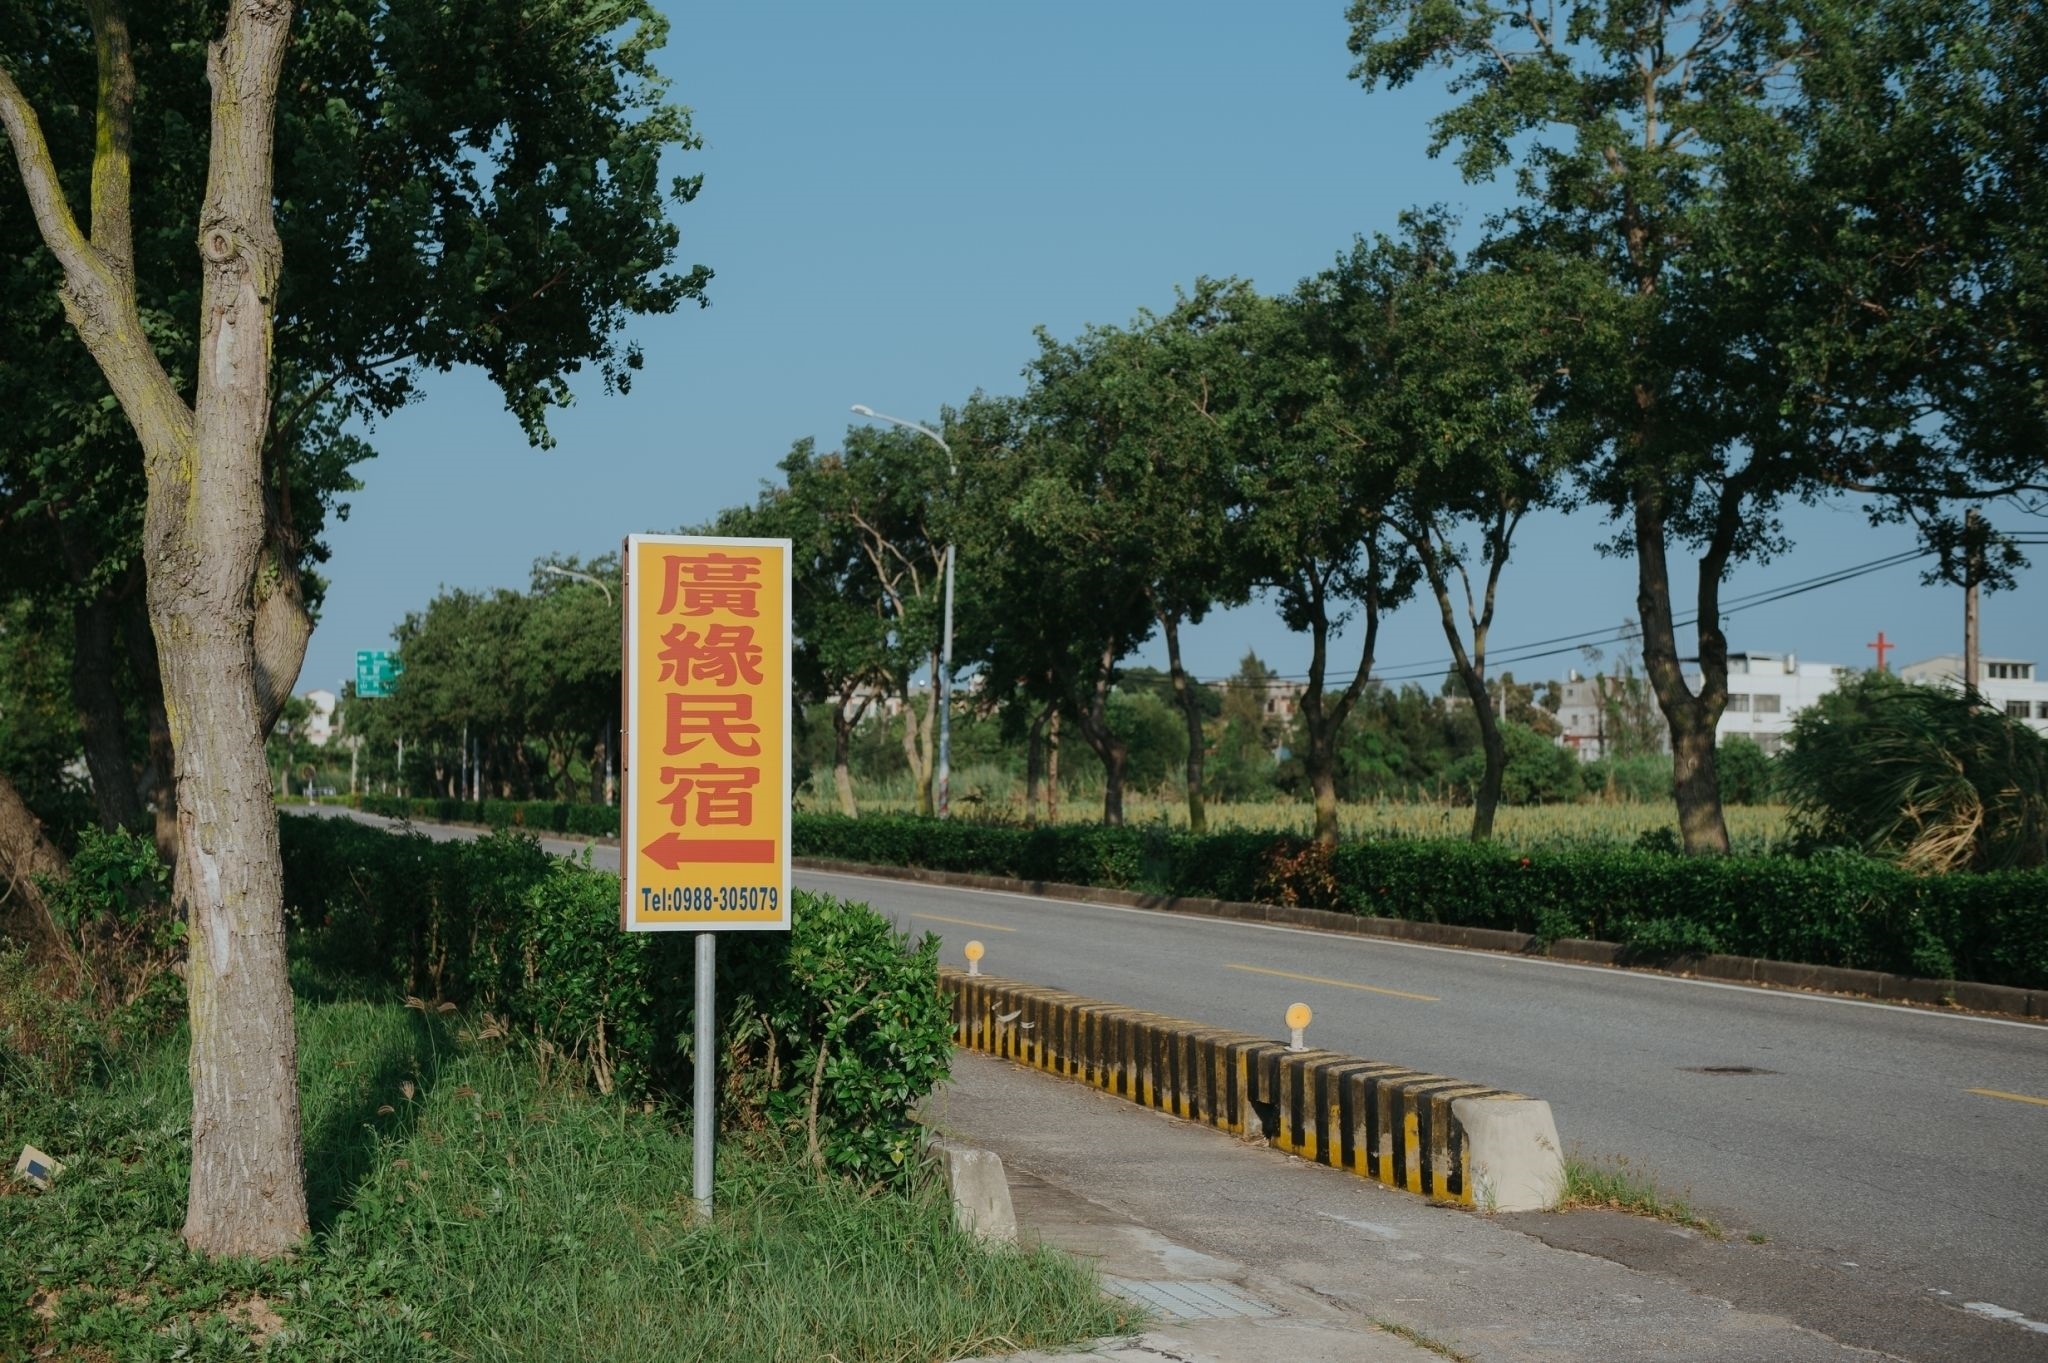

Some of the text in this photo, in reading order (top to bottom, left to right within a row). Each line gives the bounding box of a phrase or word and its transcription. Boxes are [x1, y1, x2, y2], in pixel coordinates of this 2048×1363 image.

[656, 553, 764, 827] 廣緣民宿
[641, 886, 778, 912] Tel:0988-305079
